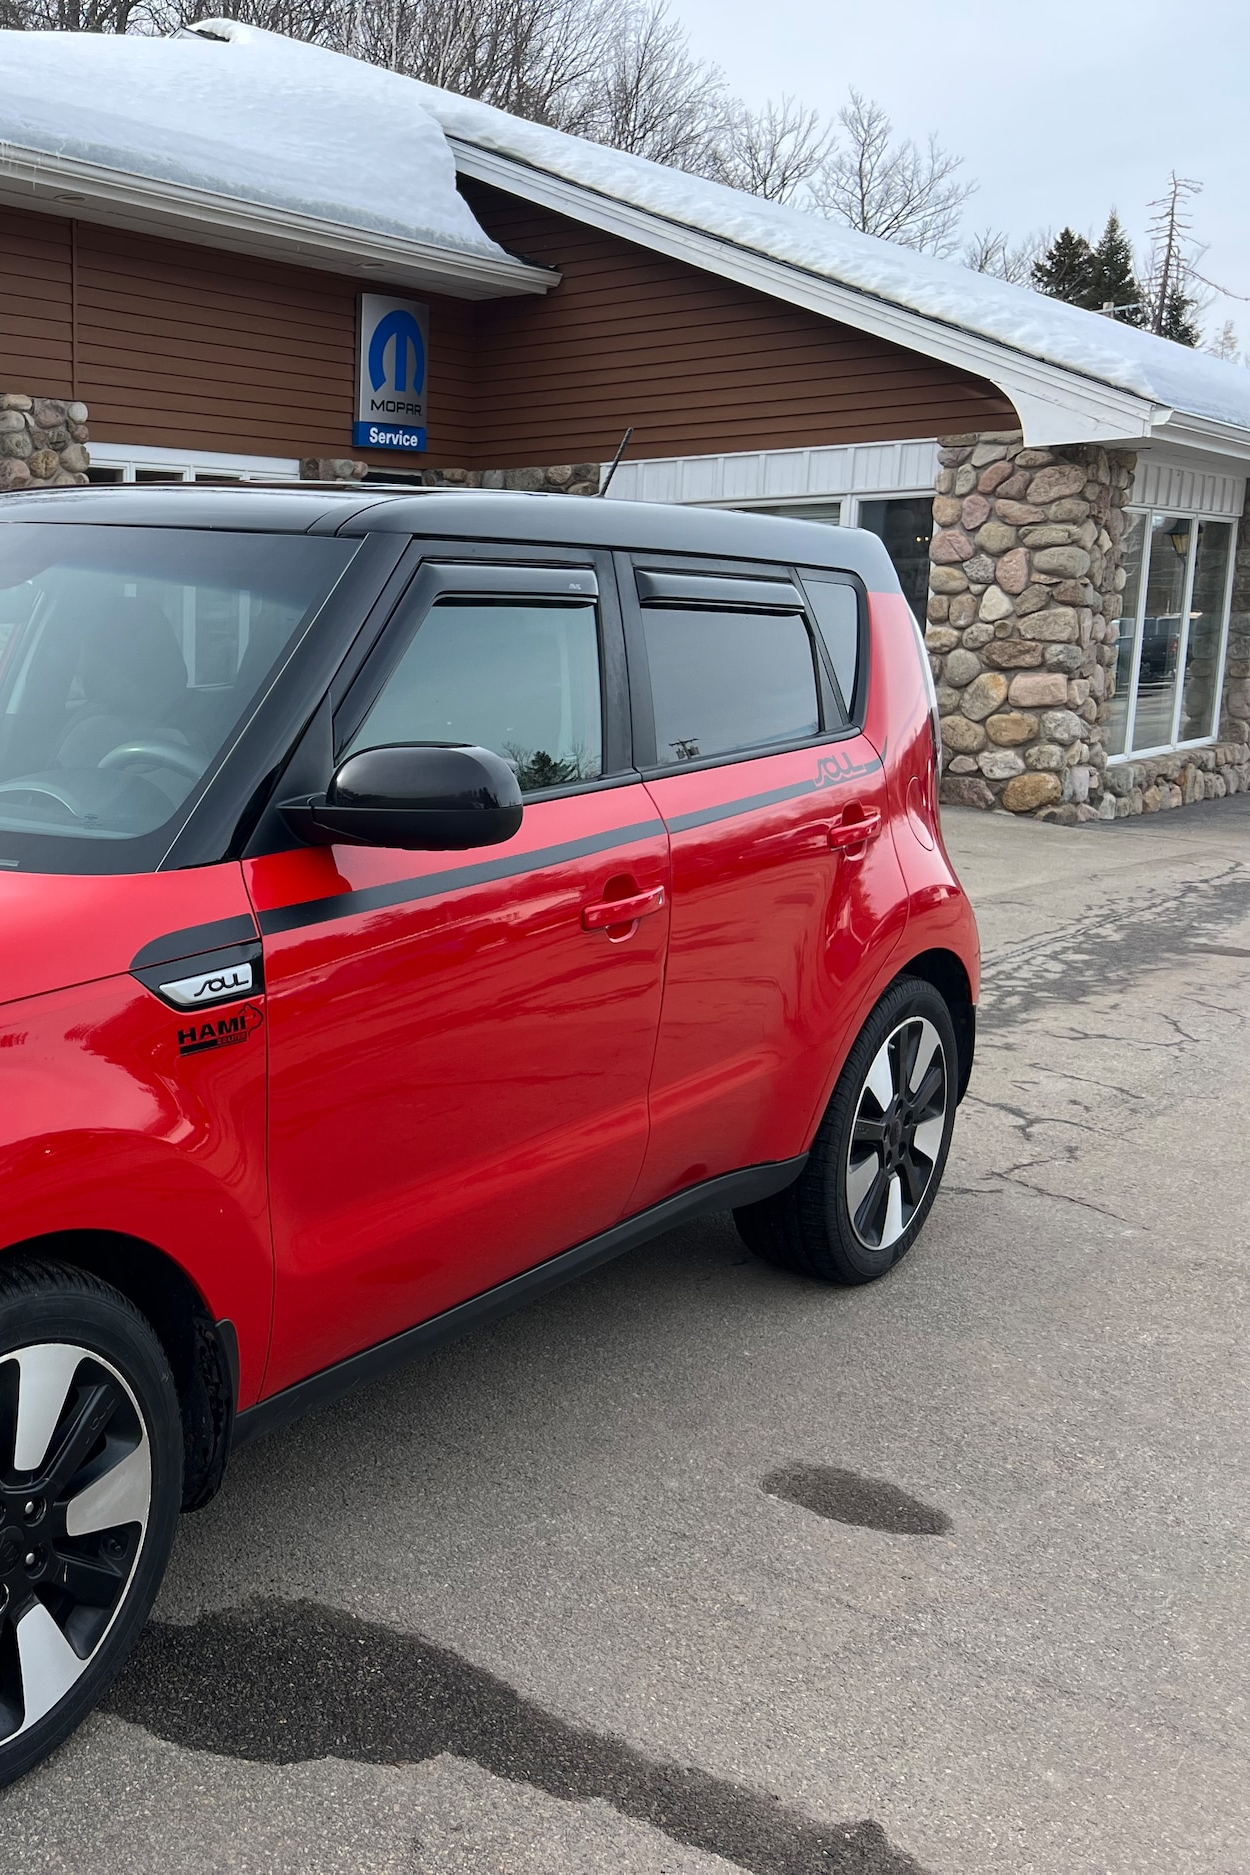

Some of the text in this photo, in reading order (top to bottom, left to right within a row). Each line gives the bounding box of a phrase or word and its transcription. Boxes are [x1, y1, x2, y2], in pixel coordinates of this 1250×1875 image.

[370, 398, 423, 416] MOPAR
[368, 426, 419, 447] Service
[193, 972, 250, 998] SOUL
[177, 1015, 247, 1045] HAMI
